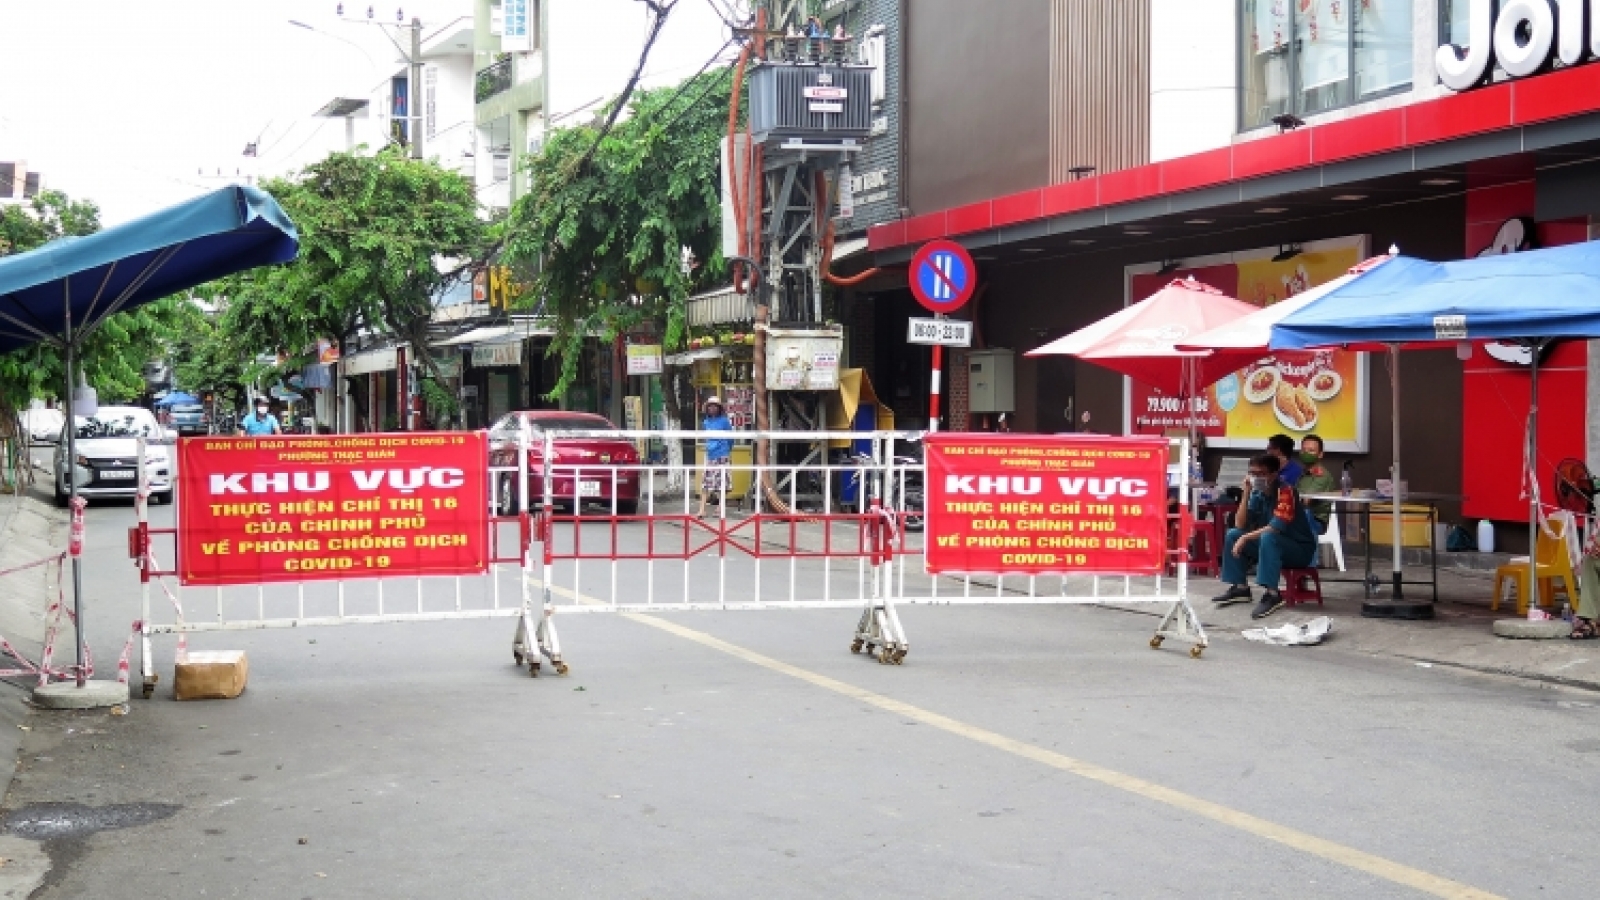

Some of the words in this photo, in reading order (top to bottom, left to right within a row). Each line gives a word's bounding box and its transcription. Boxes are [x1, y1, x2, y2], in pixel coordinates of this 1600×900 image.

[411, 436, 465, 446] COVID-19
[209, 471, 330, 495] KHU
[350, 466, 465, 494] VỰC
[945, 475, 1042, 495] KHU
[1057, 476, 1149, 500] VỰC
[209, 502, 272, 518] THỰC
[279, 498, 336, 516] HIỆN
[388, 498, 424, 512] THỊ
[431, 496, 458, 510] 16
[945, 500, 994, 516] THỰC
[1000, 500, 1044, 516] HIỆN
[1086, 504, 1115, 517] THỊ
[1121, 504, 1142, 517] 16
[244, 518, 293, 535] CỦA
[300, 518, 372, 532] CHÍNH
[380, 513, 426, 530] PHỦ
[972, 516, 1010, 531] CỦA
[1015, 517, 1074, 532] CHÍNH
[1079, 517, 1117, 532] PHỦ
[238, 537, 321, 554] PHÒNG
[327, 533, 407, 551] CHỐNG
[413, 534, 468, 550] DỊCH
[965, 534, 1031, 549] PHÒNG
[1036, 532, 1101, 549] CHỐNG
[1105, 537, 1149, 551] DỊCH
[283, 555, 391, 571] COVID-19
[1002, 553, 1087, 566] COVID-19
